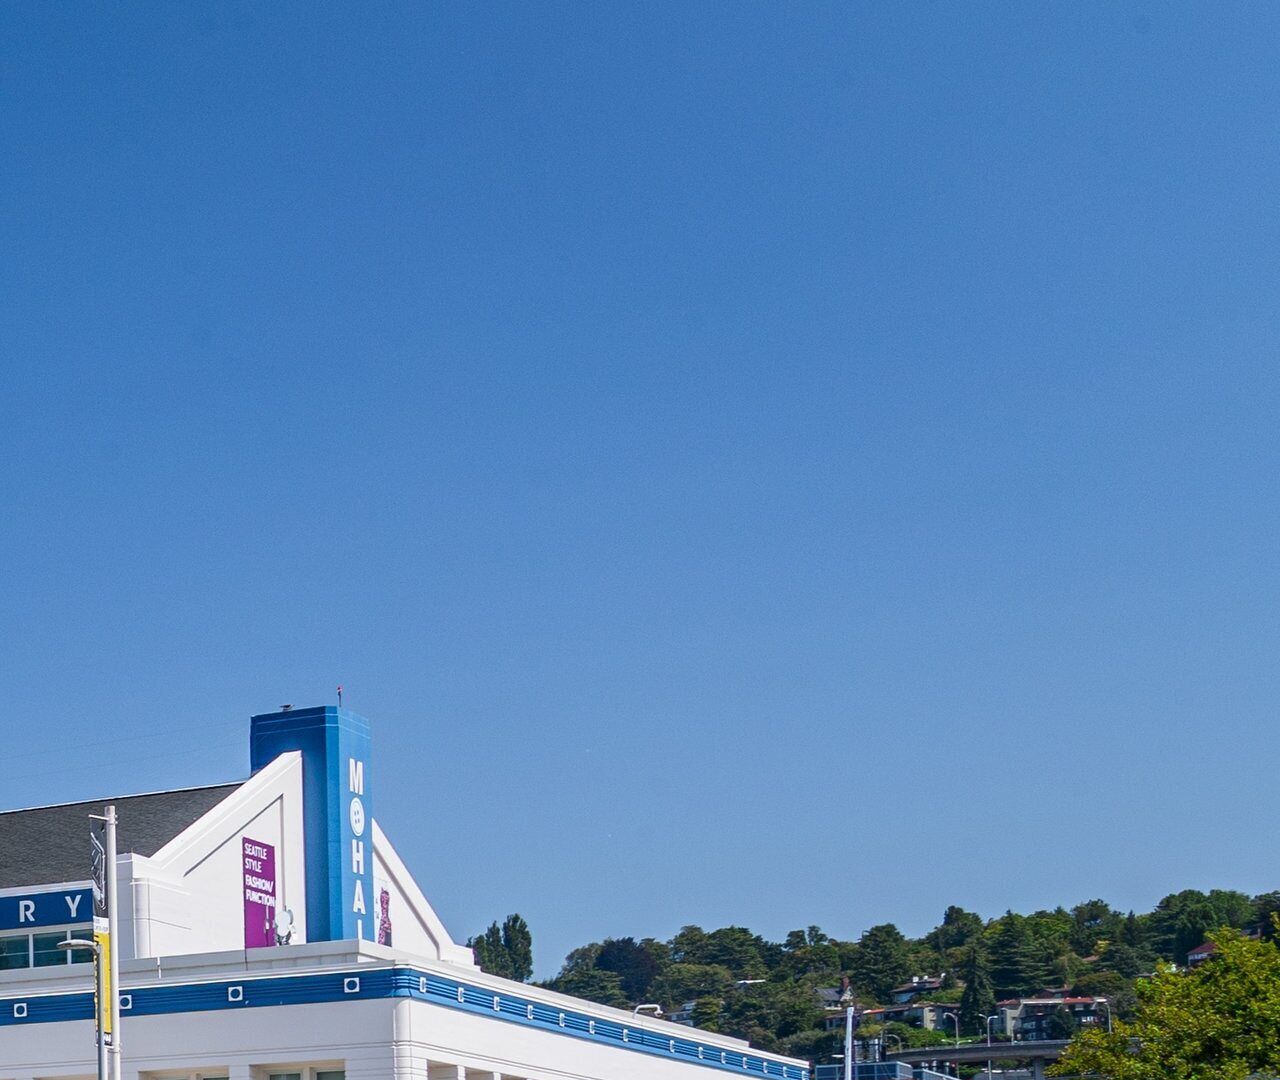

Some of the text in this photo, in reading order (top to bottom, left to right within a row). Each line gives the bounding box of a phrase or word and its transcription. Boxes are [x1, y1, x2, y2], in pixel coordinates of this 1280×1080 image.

[244, 842, 267, 860] SEATTLE
[244, 857, 262, 873] STYLE
[245, 889, 275, 907] FUNCTION
